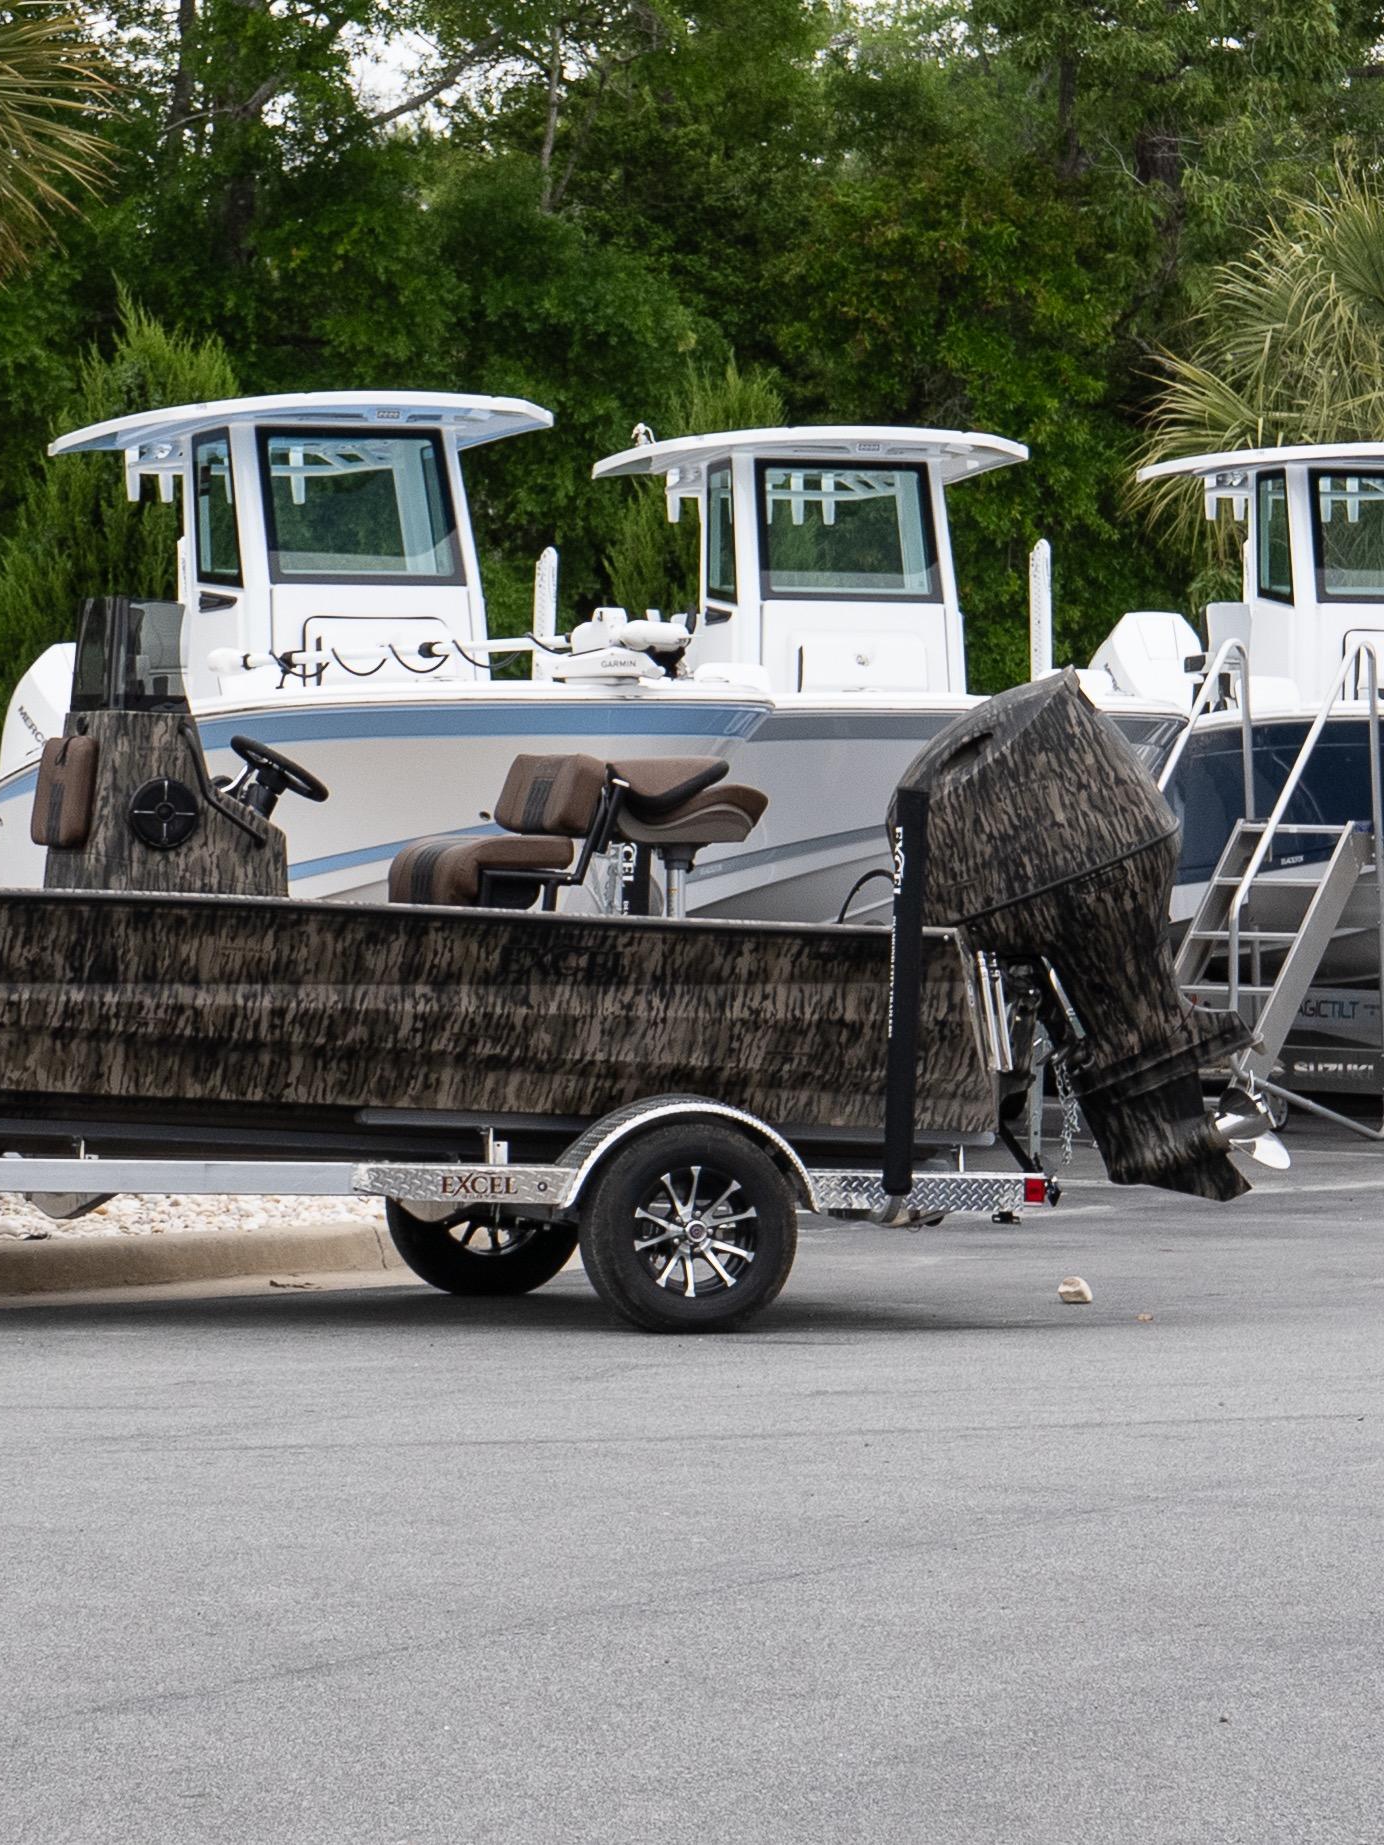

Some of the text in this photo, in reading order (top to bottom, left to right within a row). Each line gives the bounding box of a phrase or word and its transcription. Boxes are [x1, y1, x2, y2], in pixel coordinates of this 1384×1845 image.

[601, 660, 637, 668] GARMIN
[1297, 999, 1360, 1019] AGICTILT
[1293, 1061, 1374, 1080] SUZUKI
[441, 1171, 518, 1197] EXCEL
